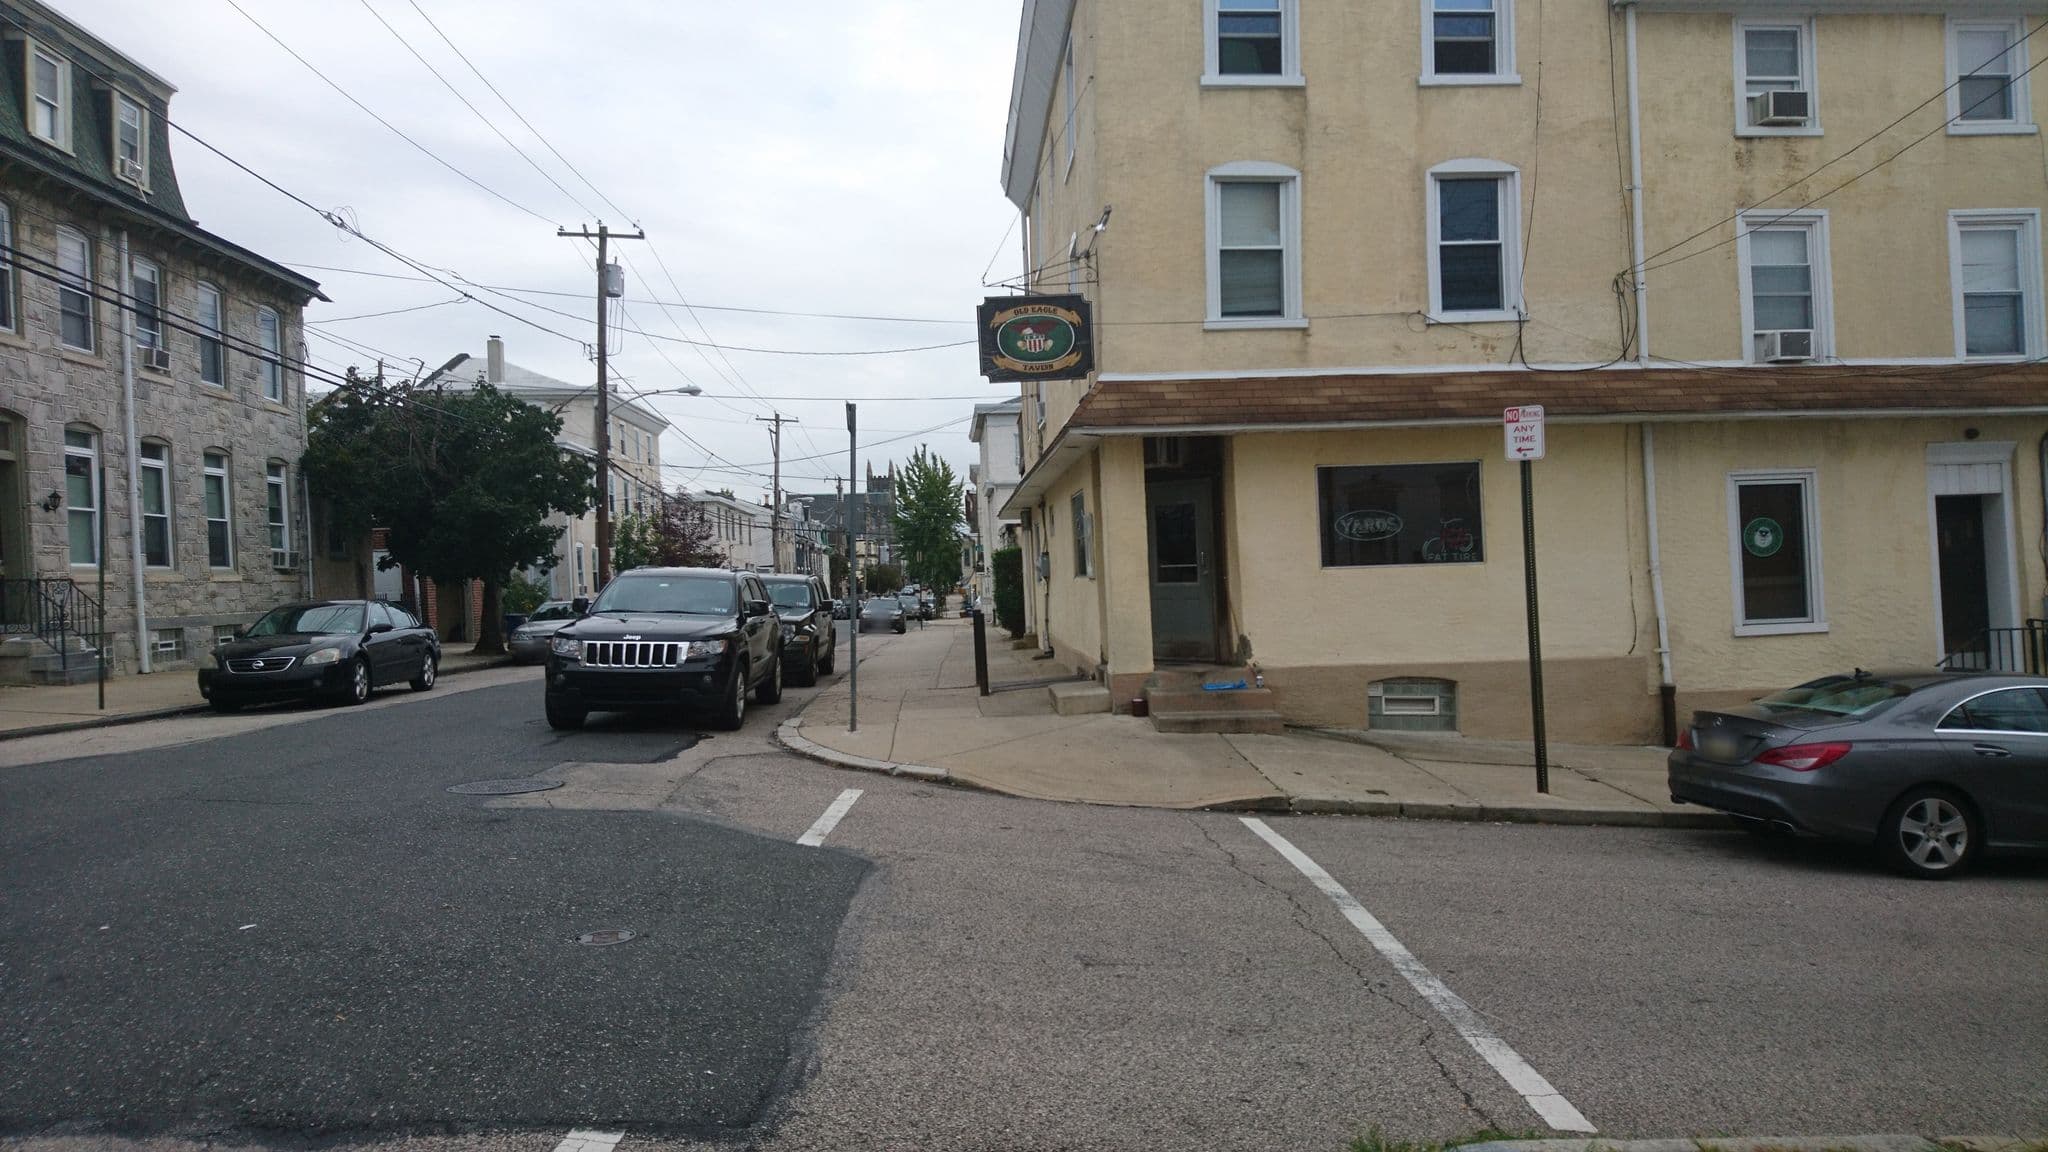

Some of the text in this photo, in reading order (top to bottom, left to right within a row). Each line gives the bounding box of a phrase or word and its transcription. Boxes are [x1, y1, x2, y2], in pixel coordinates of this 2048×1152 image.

[1014, 306, 1058, 315] OLD EAGLE
[1507, 410, 1518, 421] NO
[1513, 435, 1535, 443] TIME
[1340, 516, 1398, 535] YARDS
[1428, 553, 1477, 561] FAT TIRE
